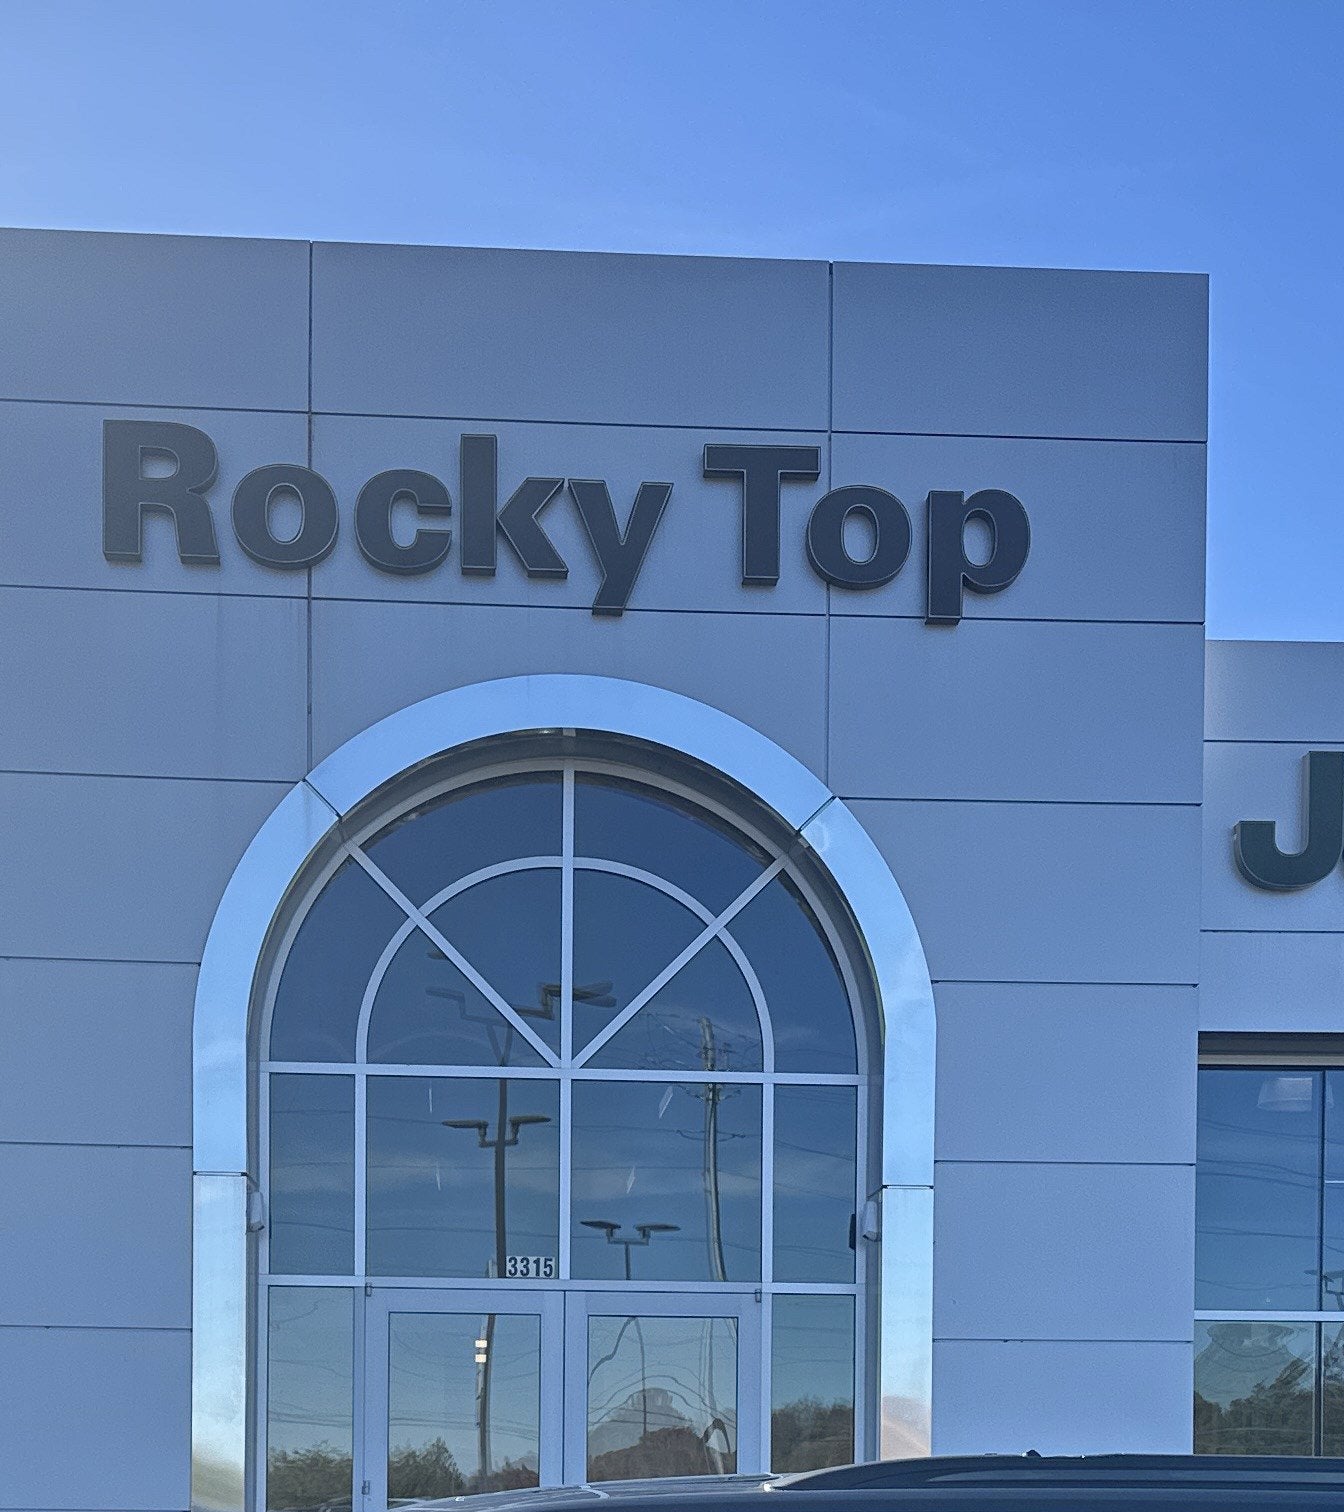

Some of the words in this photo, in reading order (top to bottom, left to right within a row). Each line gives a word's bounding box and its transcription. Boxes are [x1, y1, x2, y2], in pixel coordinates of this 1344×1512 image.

[102, 418, 674, 616] Rocky
[702, 443, 1032, 625] Top
[508, 1256, 553, 1277] 3315
